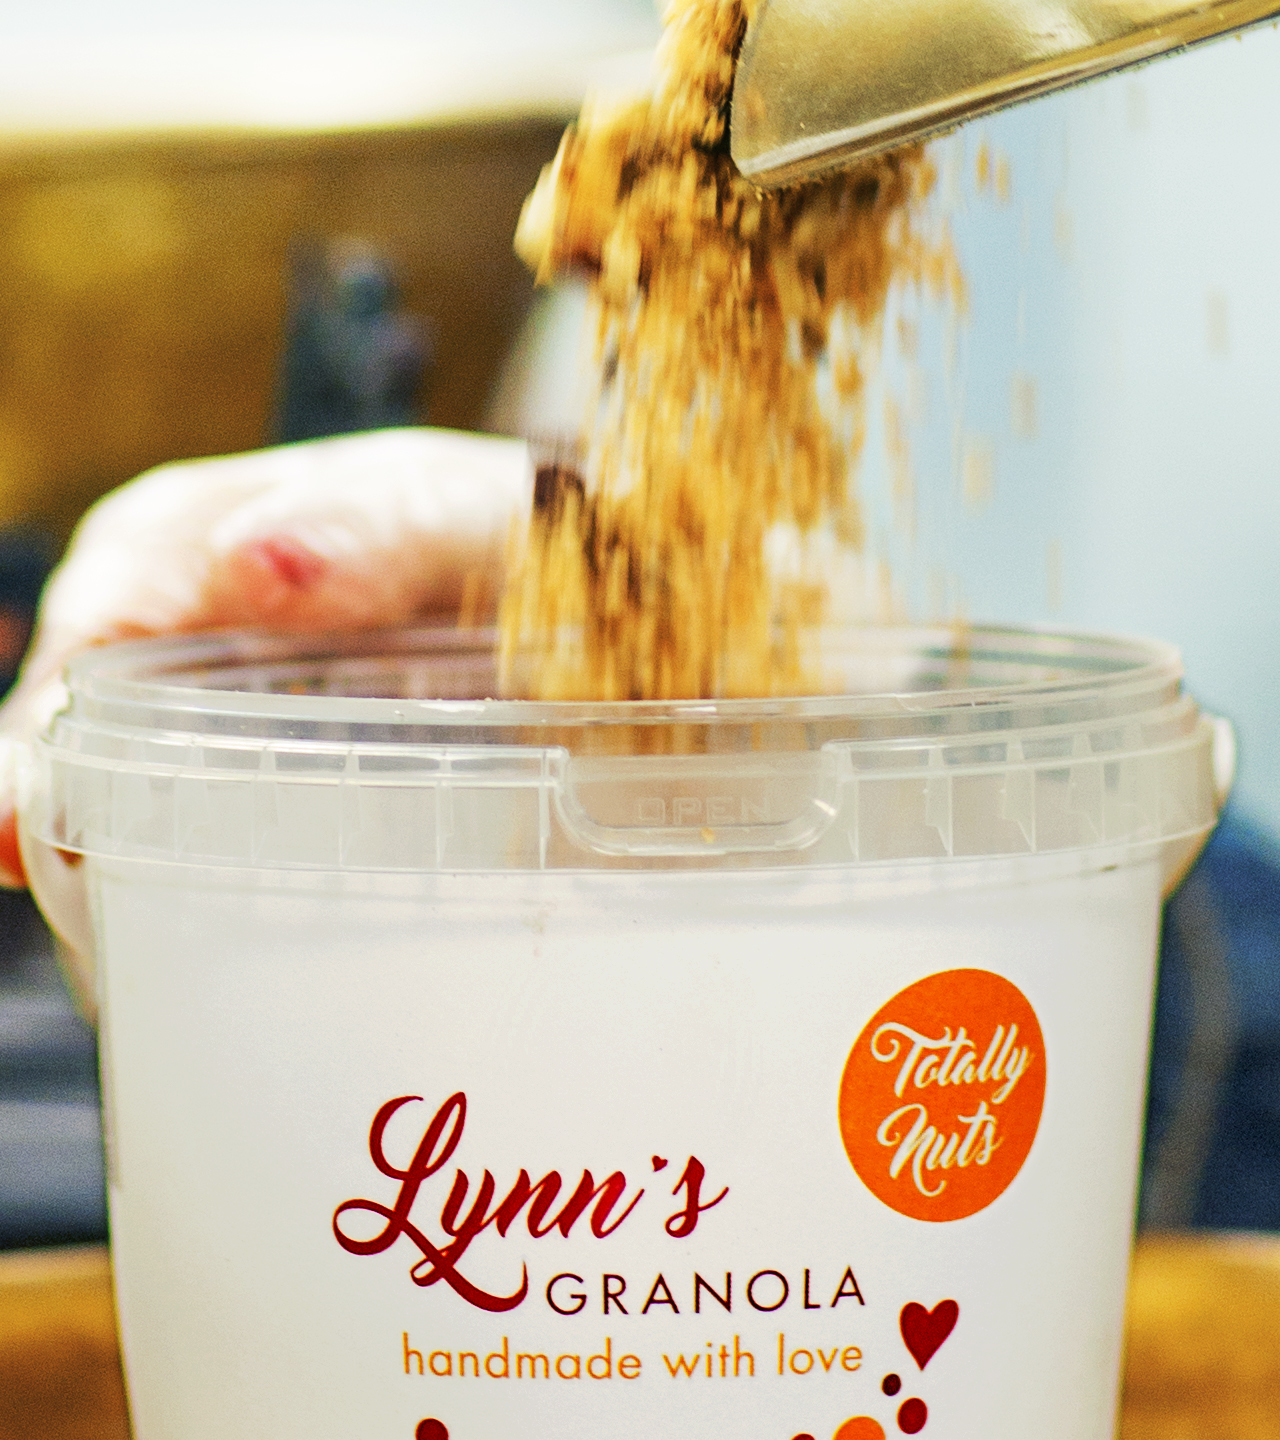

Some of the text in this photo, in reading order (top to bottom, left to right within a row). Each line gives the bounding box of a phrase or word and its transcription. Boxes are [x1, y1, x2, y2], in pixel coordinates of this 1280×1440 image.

[637, 796, 770, 825] OPEN
[870, 1022, 1034, 1102] Totally
[876, 1101, 1003, 1196] Nuts
[332, 1091, 729, 1313] Lynn's
[545, 1266, 866, 1317] GRANOLA
[402, 1332, 864, 1381] handmade with love
